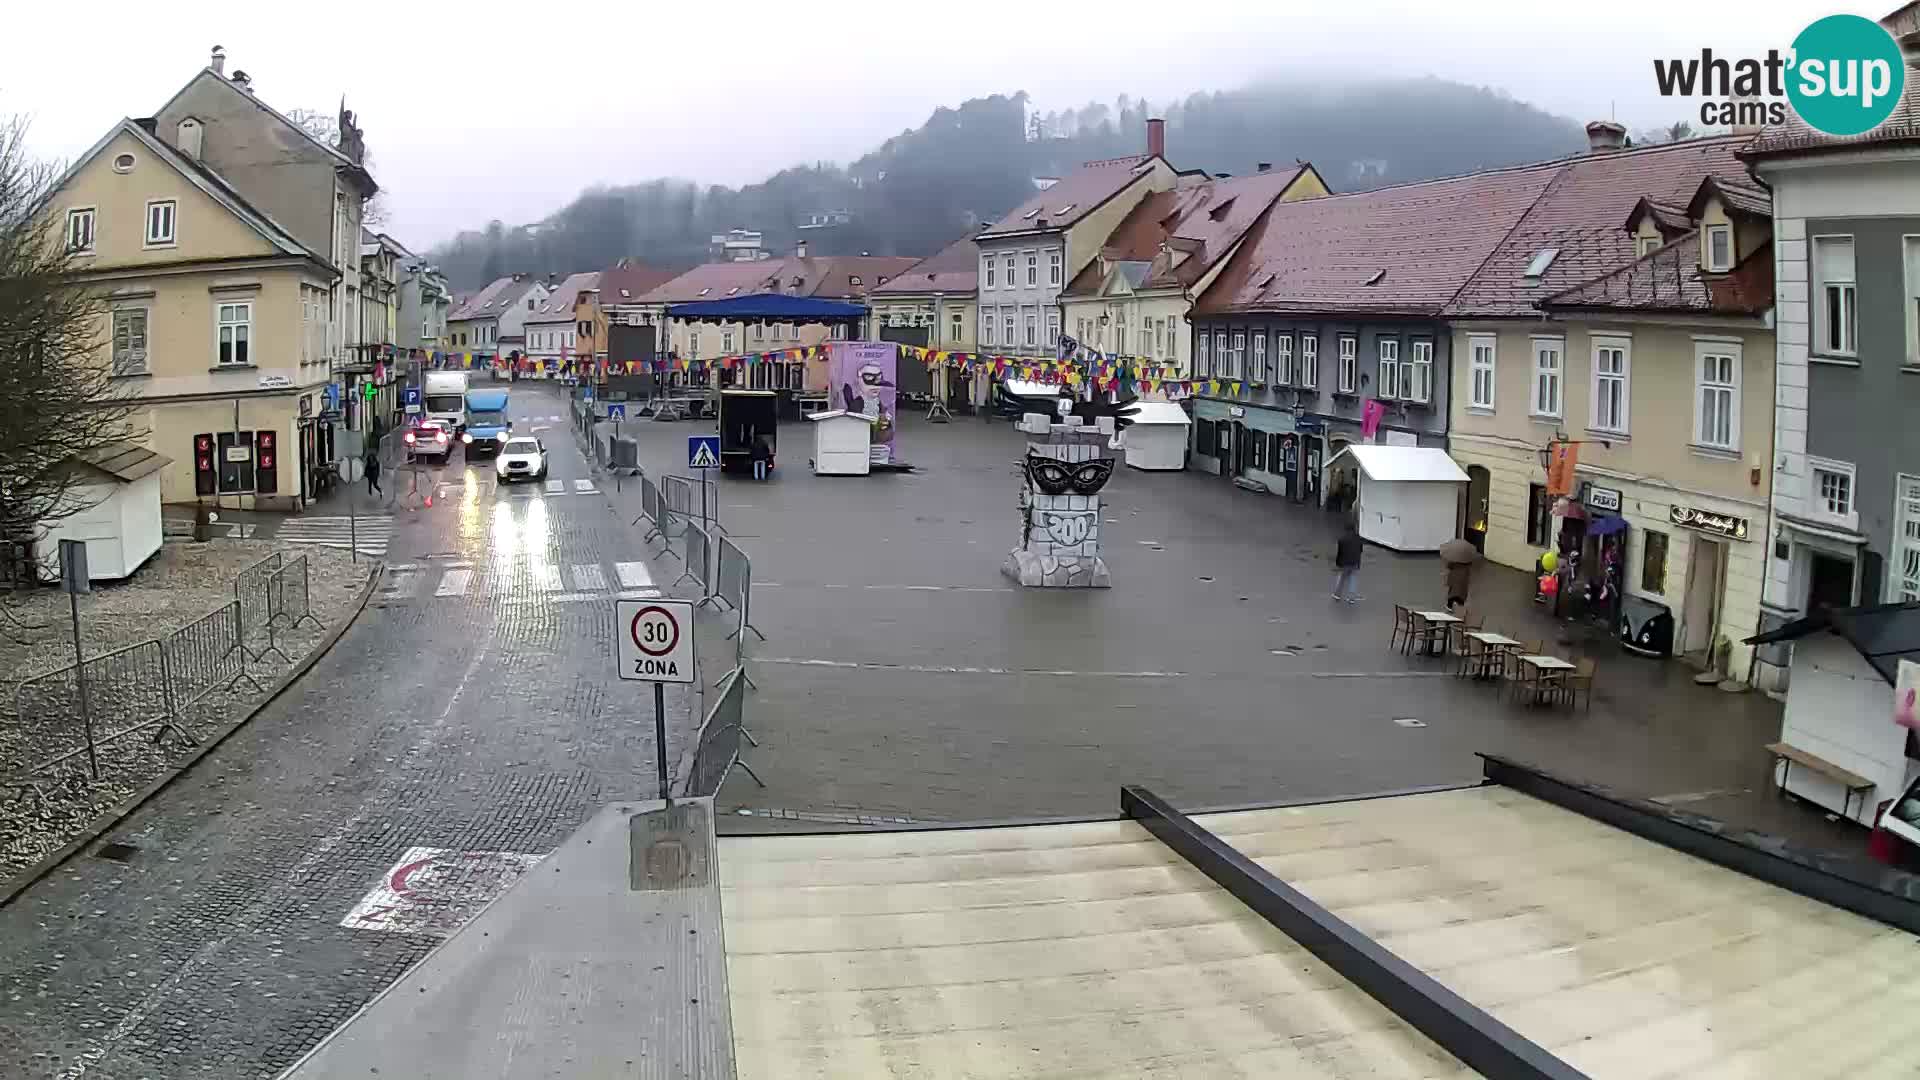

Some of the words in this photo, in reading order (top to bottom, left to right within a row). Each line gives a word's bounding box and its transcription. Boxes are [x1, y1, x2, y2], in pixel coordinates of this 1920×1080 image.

[1048, 515, 1087, 545] 200
[644, 622, 667, 642] 30
[634, 659, 678, 676] ZONA
